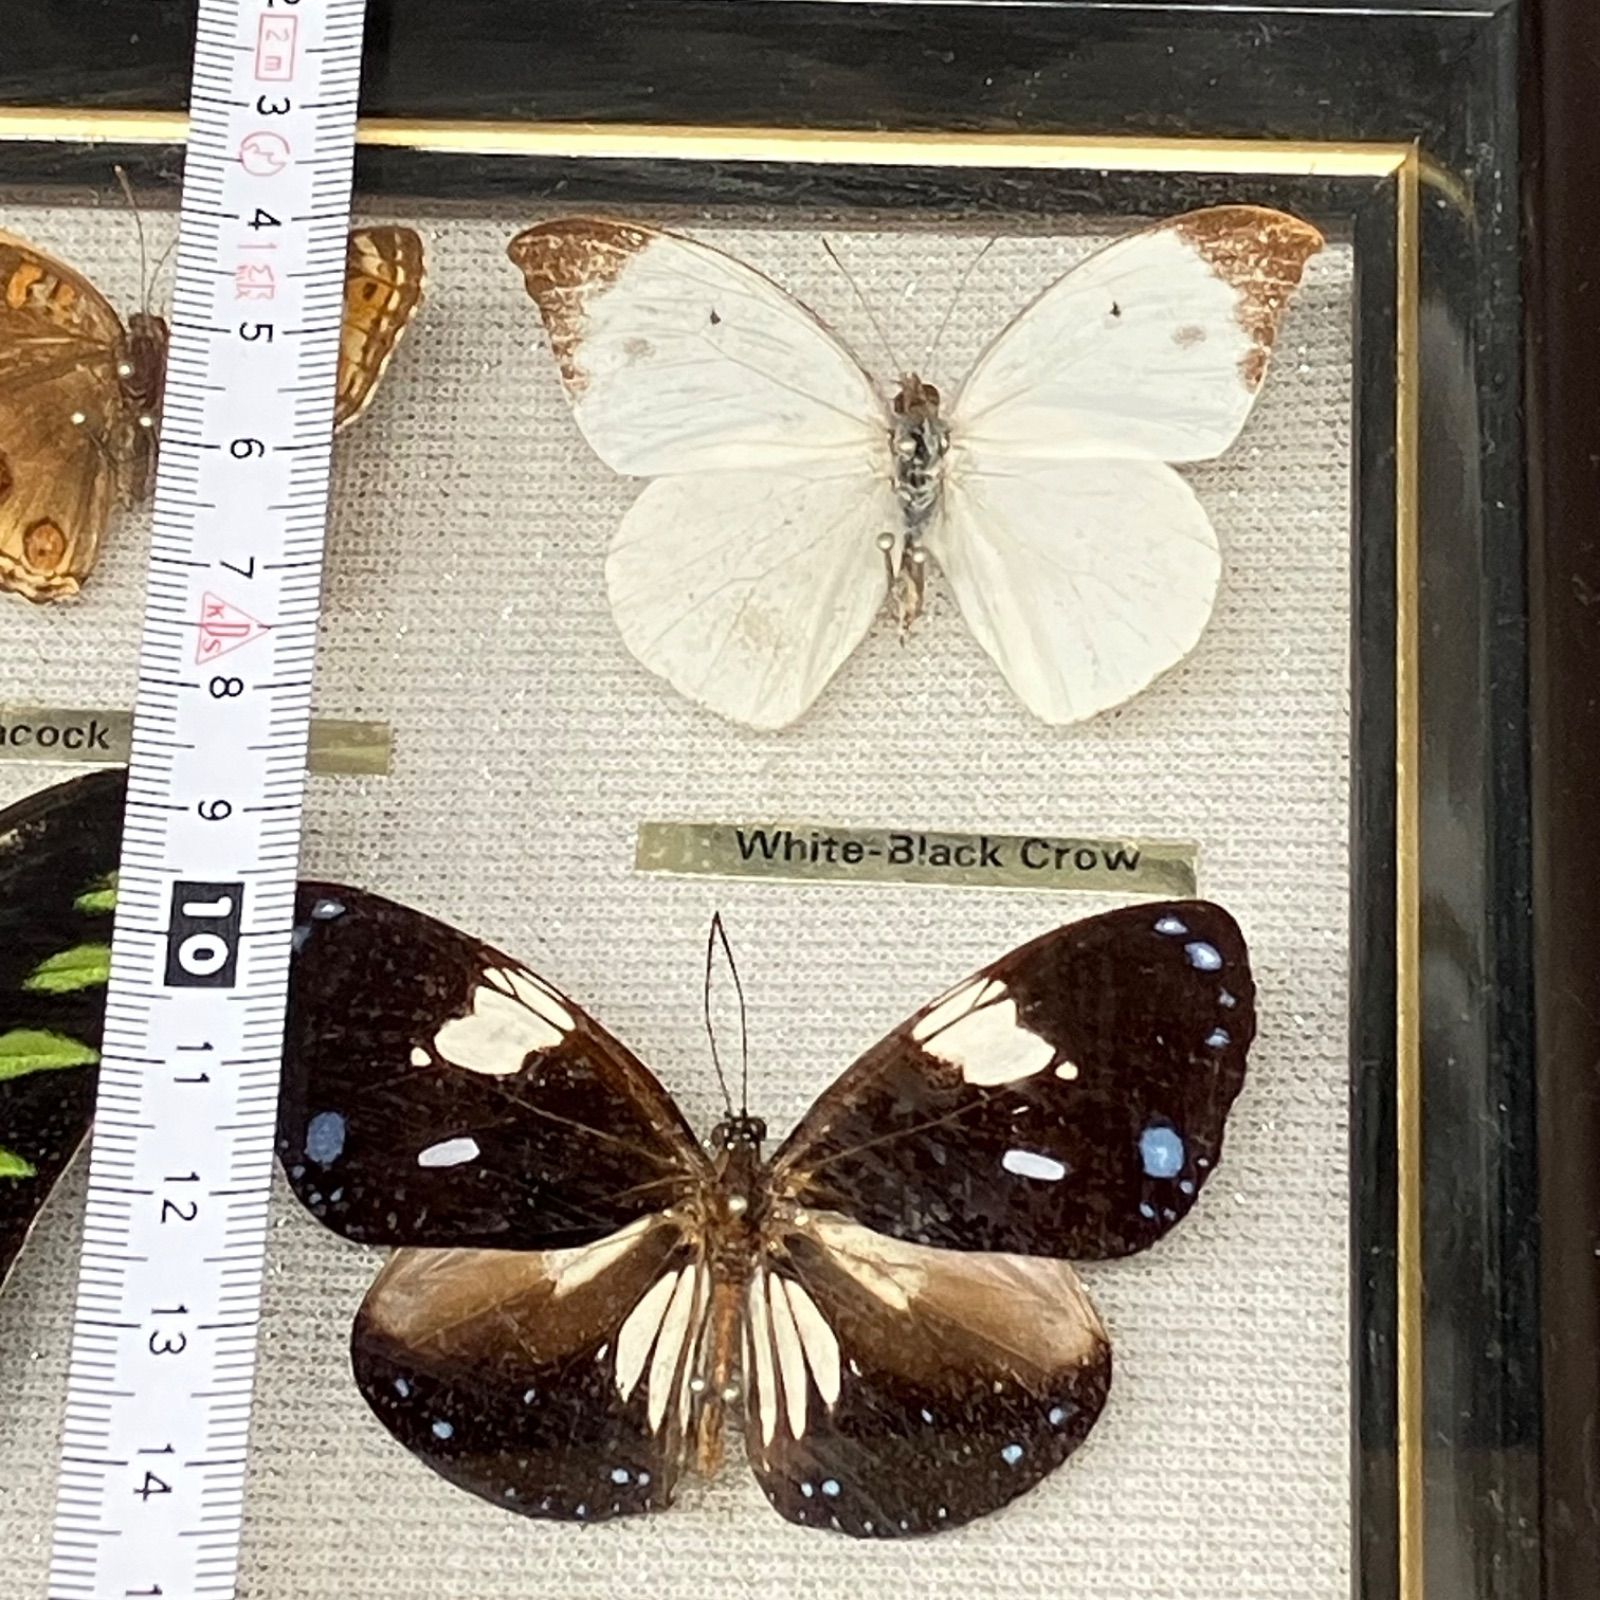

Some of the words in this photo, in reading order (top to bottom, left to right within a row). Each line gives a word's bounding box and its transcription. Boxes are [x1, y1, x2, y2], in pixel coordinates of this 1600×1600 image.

[256, 94, 291, 116] 3
[247, 207, 282, 231] 4
[239, 321, 274, 344] 5
[230, 437, 265, 460] 6
[219, 555, 255, 580] 7
[208, 674, 245, 700] 8
[197, 798, 233, 822] 9
[1020, 838, 1141, 871] Crow
[178, 895, 233, 976] 10
[173, 1041, 215, 1084] 11
[160, 1170, 201, 1224] 12
[149, 1304, 189, 1357] 13
[133, 1443, 175, 1502] 14
